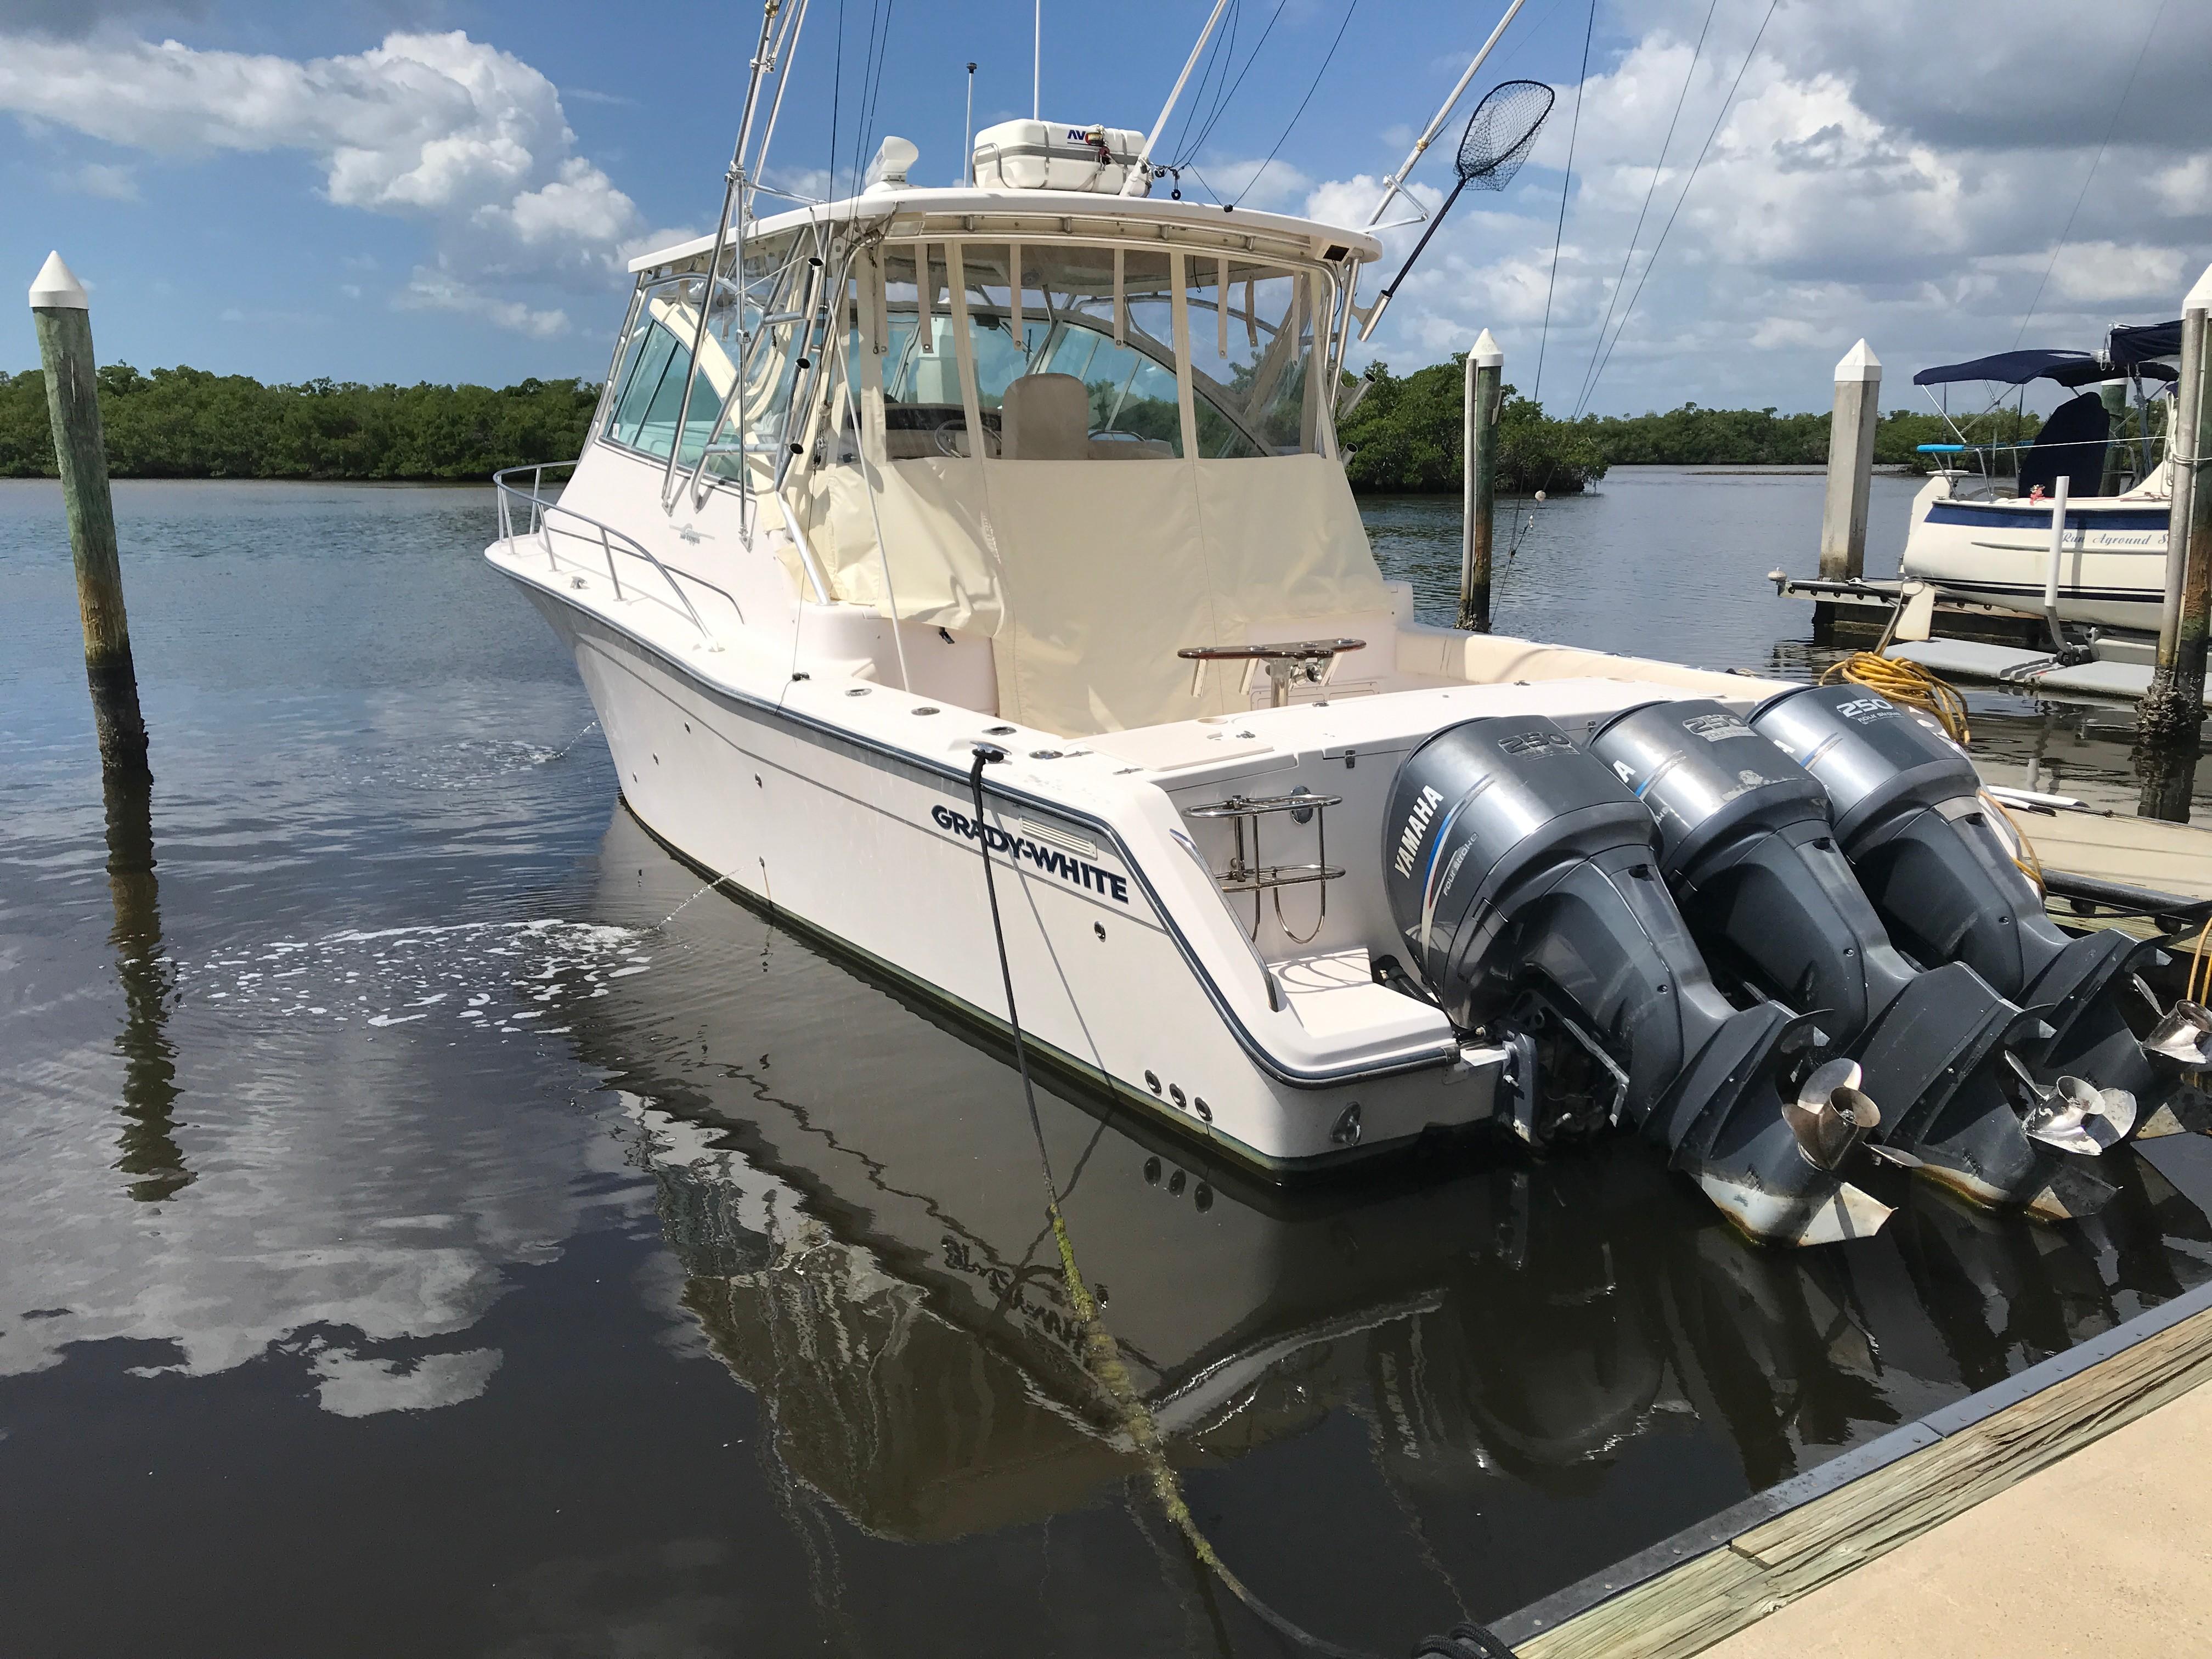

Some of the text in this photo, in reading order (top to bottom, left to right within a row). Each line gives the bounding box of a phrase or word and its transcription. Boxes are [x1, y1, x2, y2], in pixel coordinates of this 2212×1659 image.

[2063, 532, 2169, 546] Run Aground S
[1836, 698, 1894, 718] 250
[1684, 715, 1748, 733] 250
[1499, 733, 1571, 754] 250
[1394, 785, 1444, 879] YAMAHA
[930, 804, 1129, 905] GRADY-WHITE
